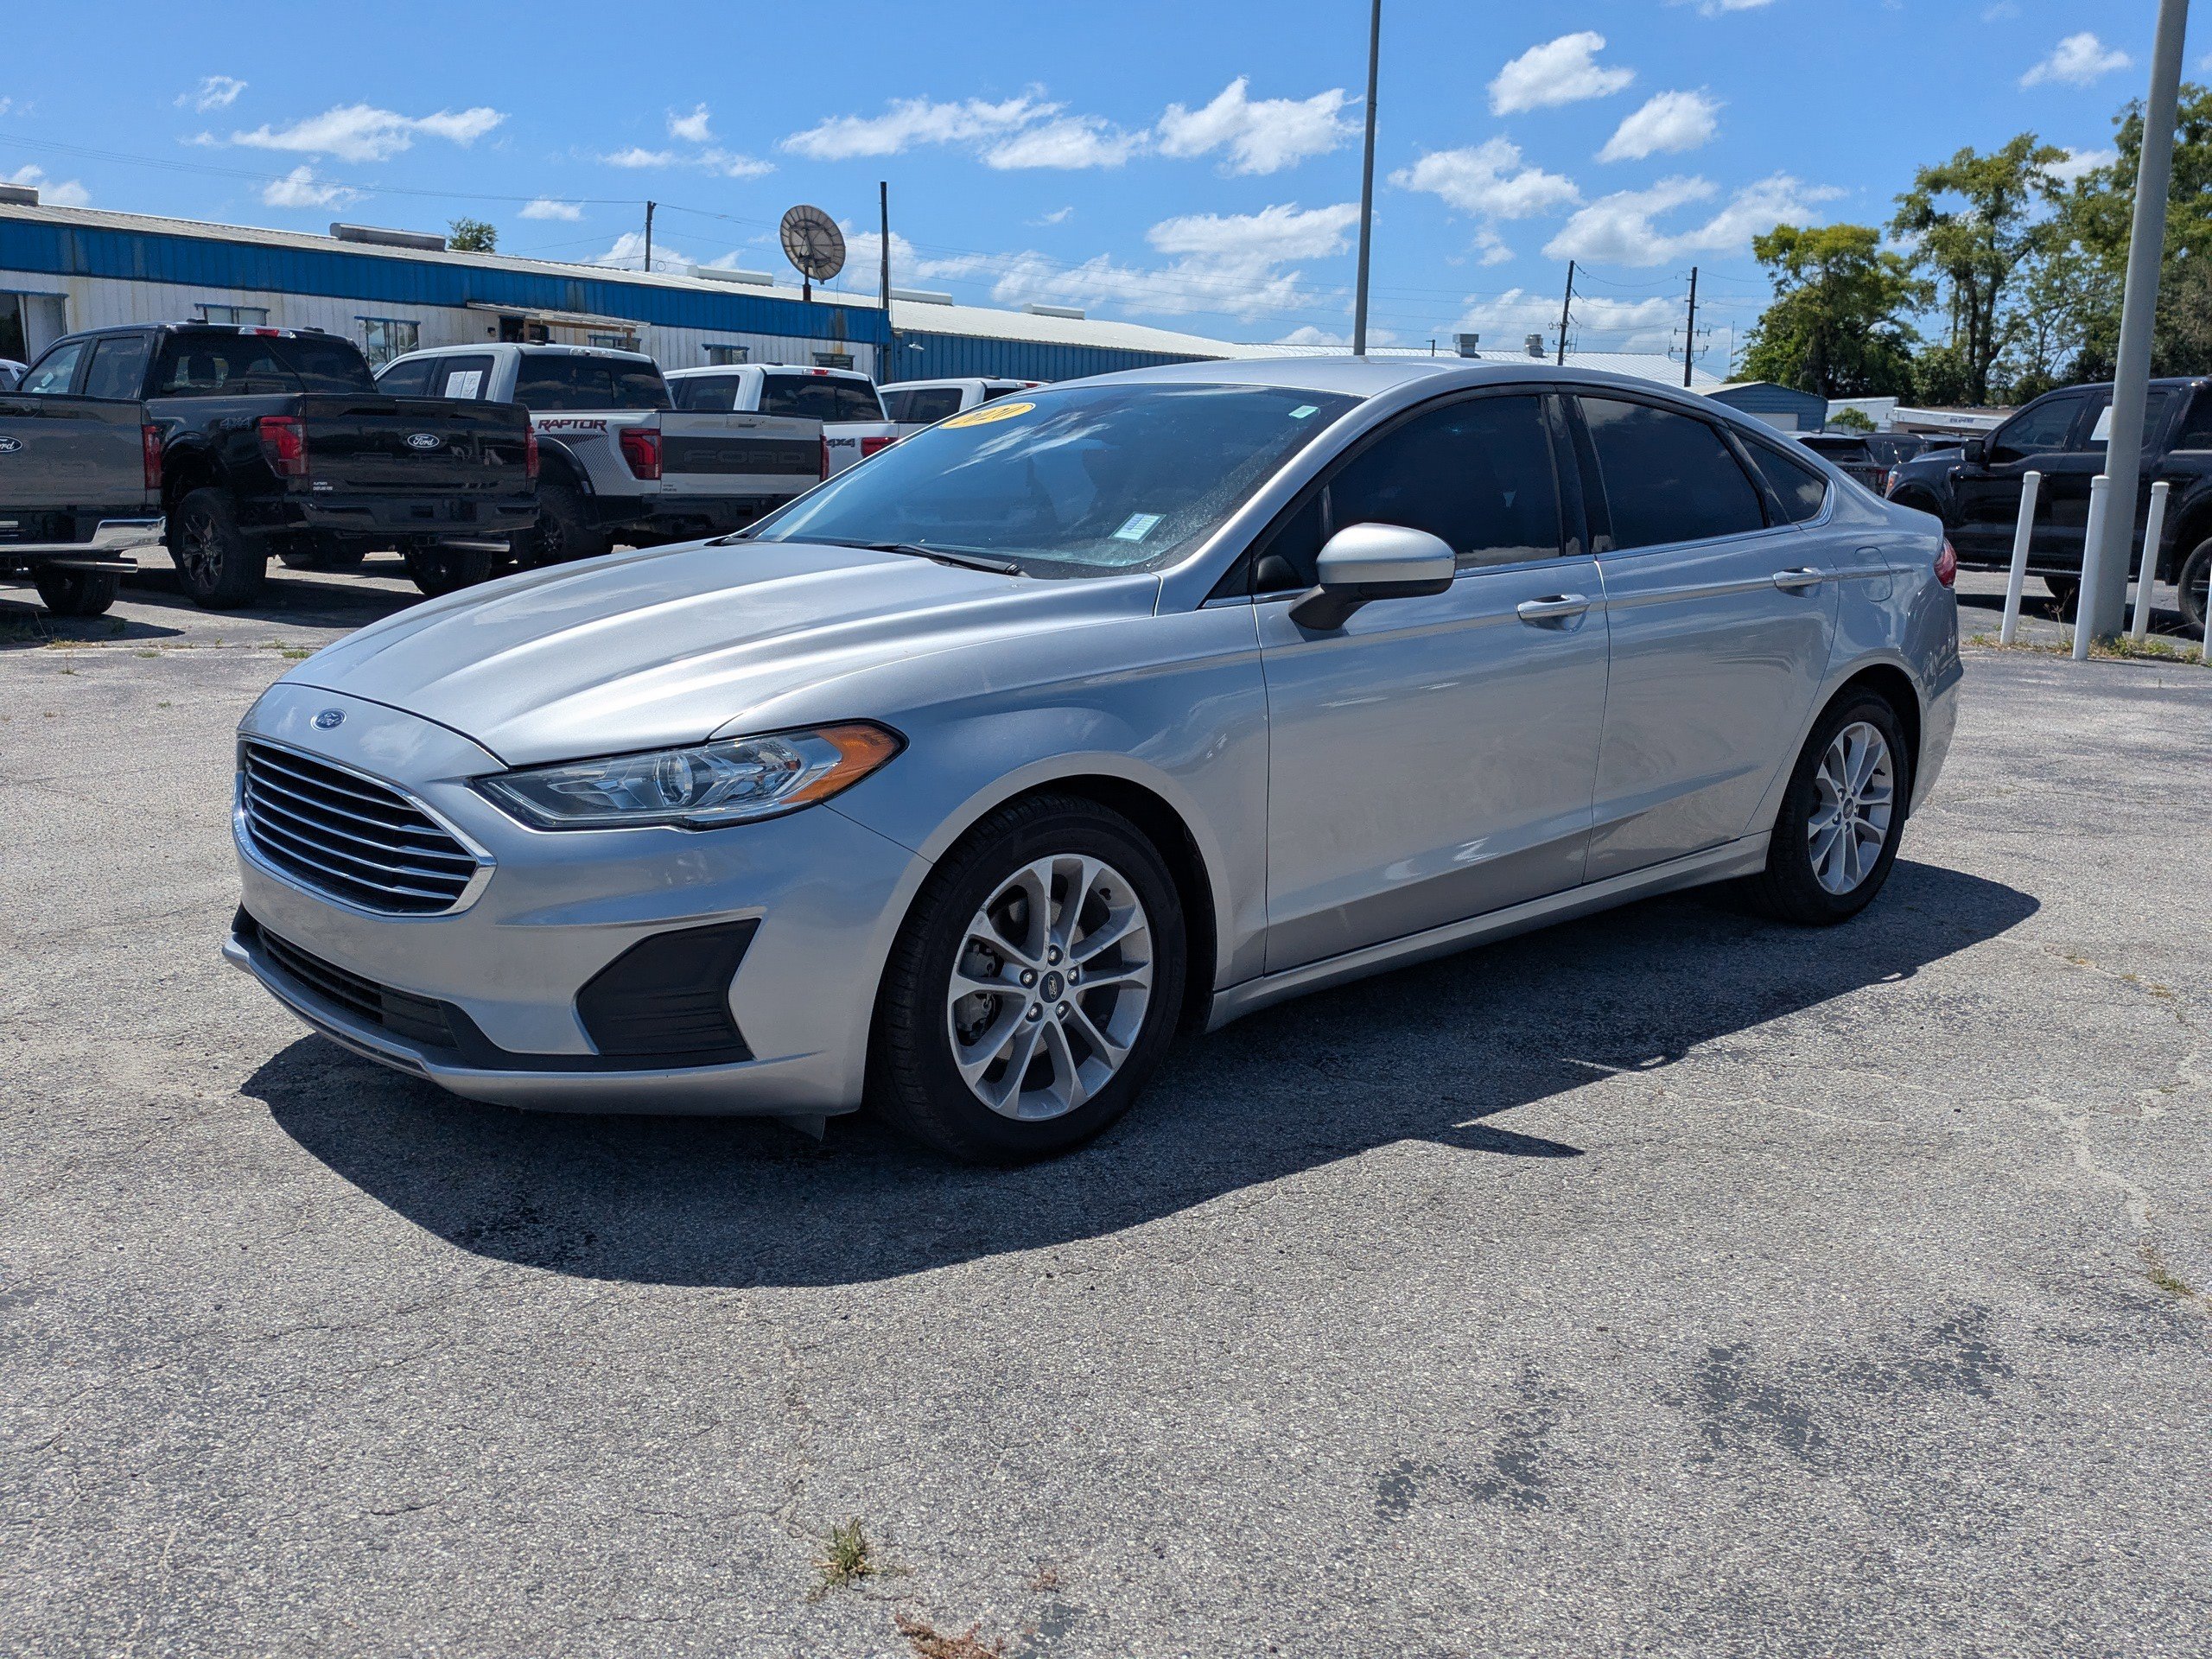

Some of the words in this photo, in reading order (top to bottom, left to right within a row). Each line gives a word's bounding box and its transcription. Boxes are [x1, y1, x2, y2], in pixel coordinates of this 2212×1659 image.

[537, 419, 608, 435] RAPTOR
[413, 435, 435, 446] Ford
[683, 449, 806, 465] FORD
